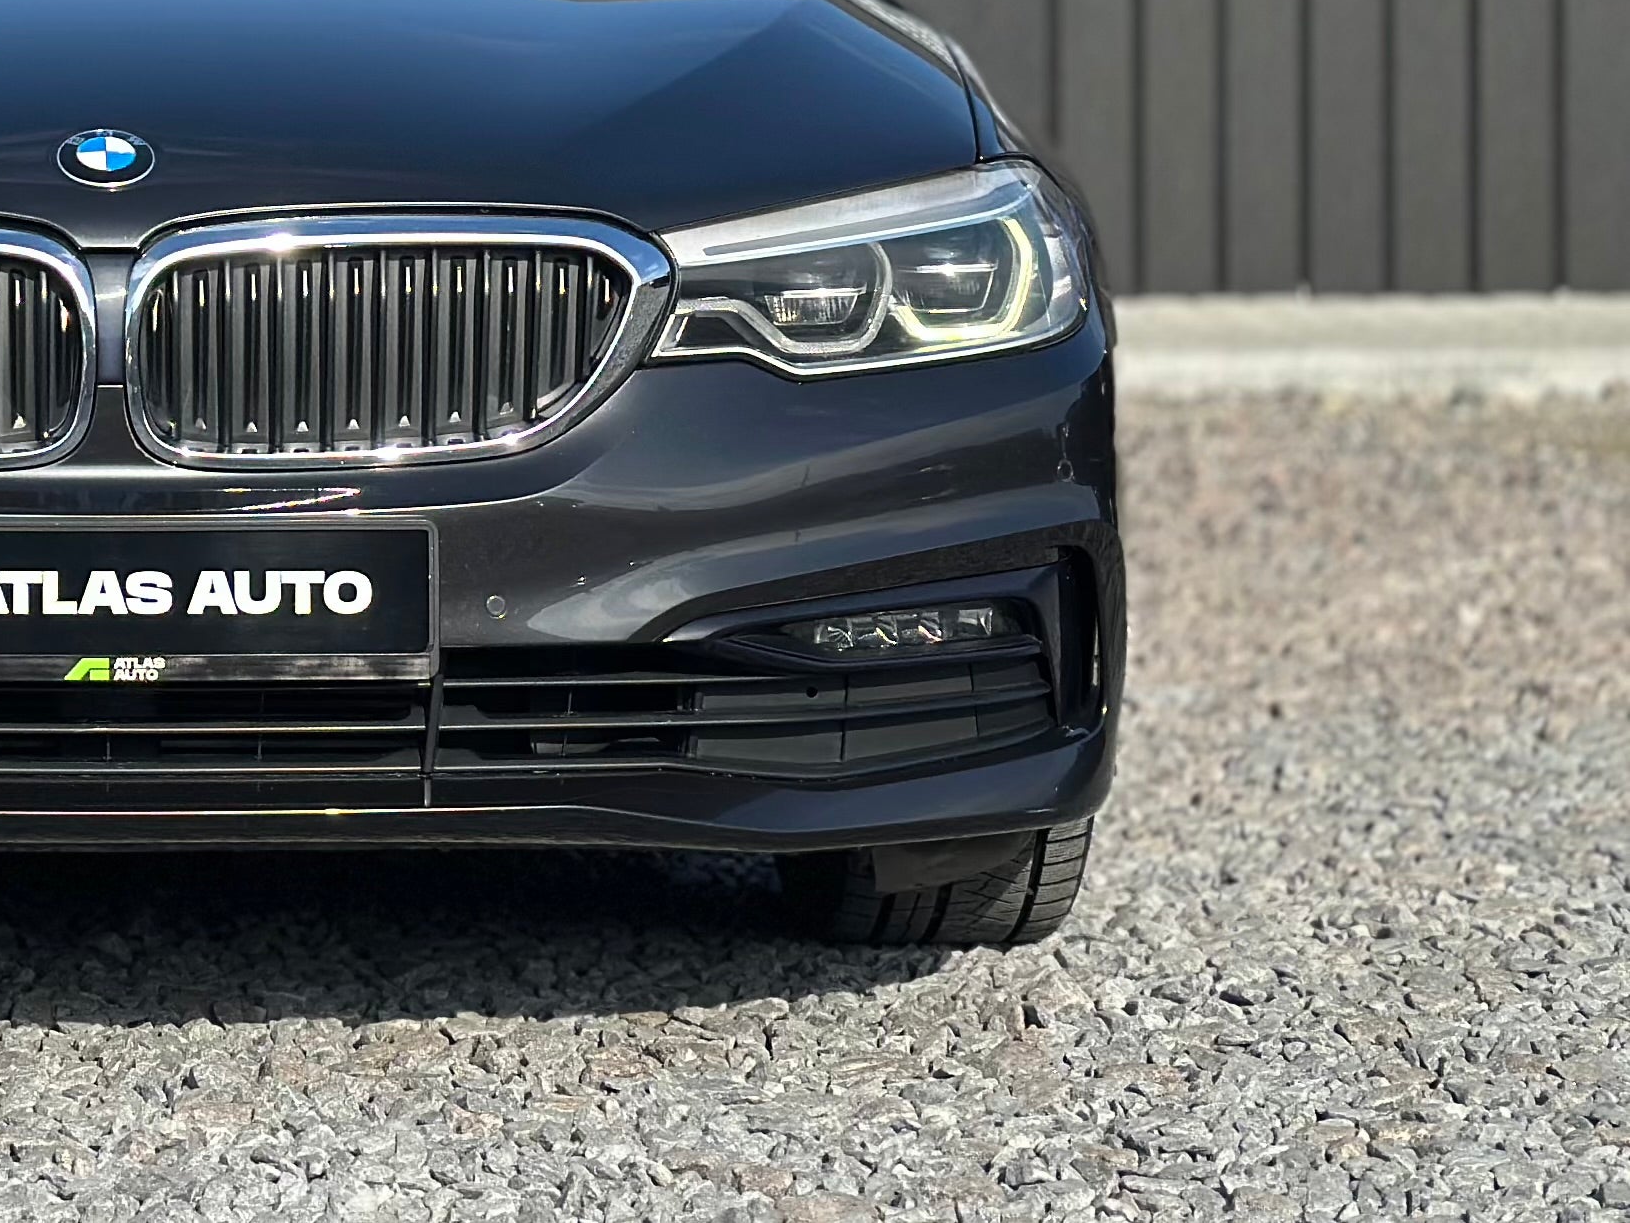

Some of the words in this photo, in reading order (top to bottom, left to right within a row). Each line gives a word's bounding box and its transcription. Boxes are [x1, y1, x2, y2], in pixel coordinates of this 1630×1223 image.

[186, 570, 373, 615] AUTO
[113, 656, 166, 669] ATLAS
[113, 668, 159, 681] AUTO
